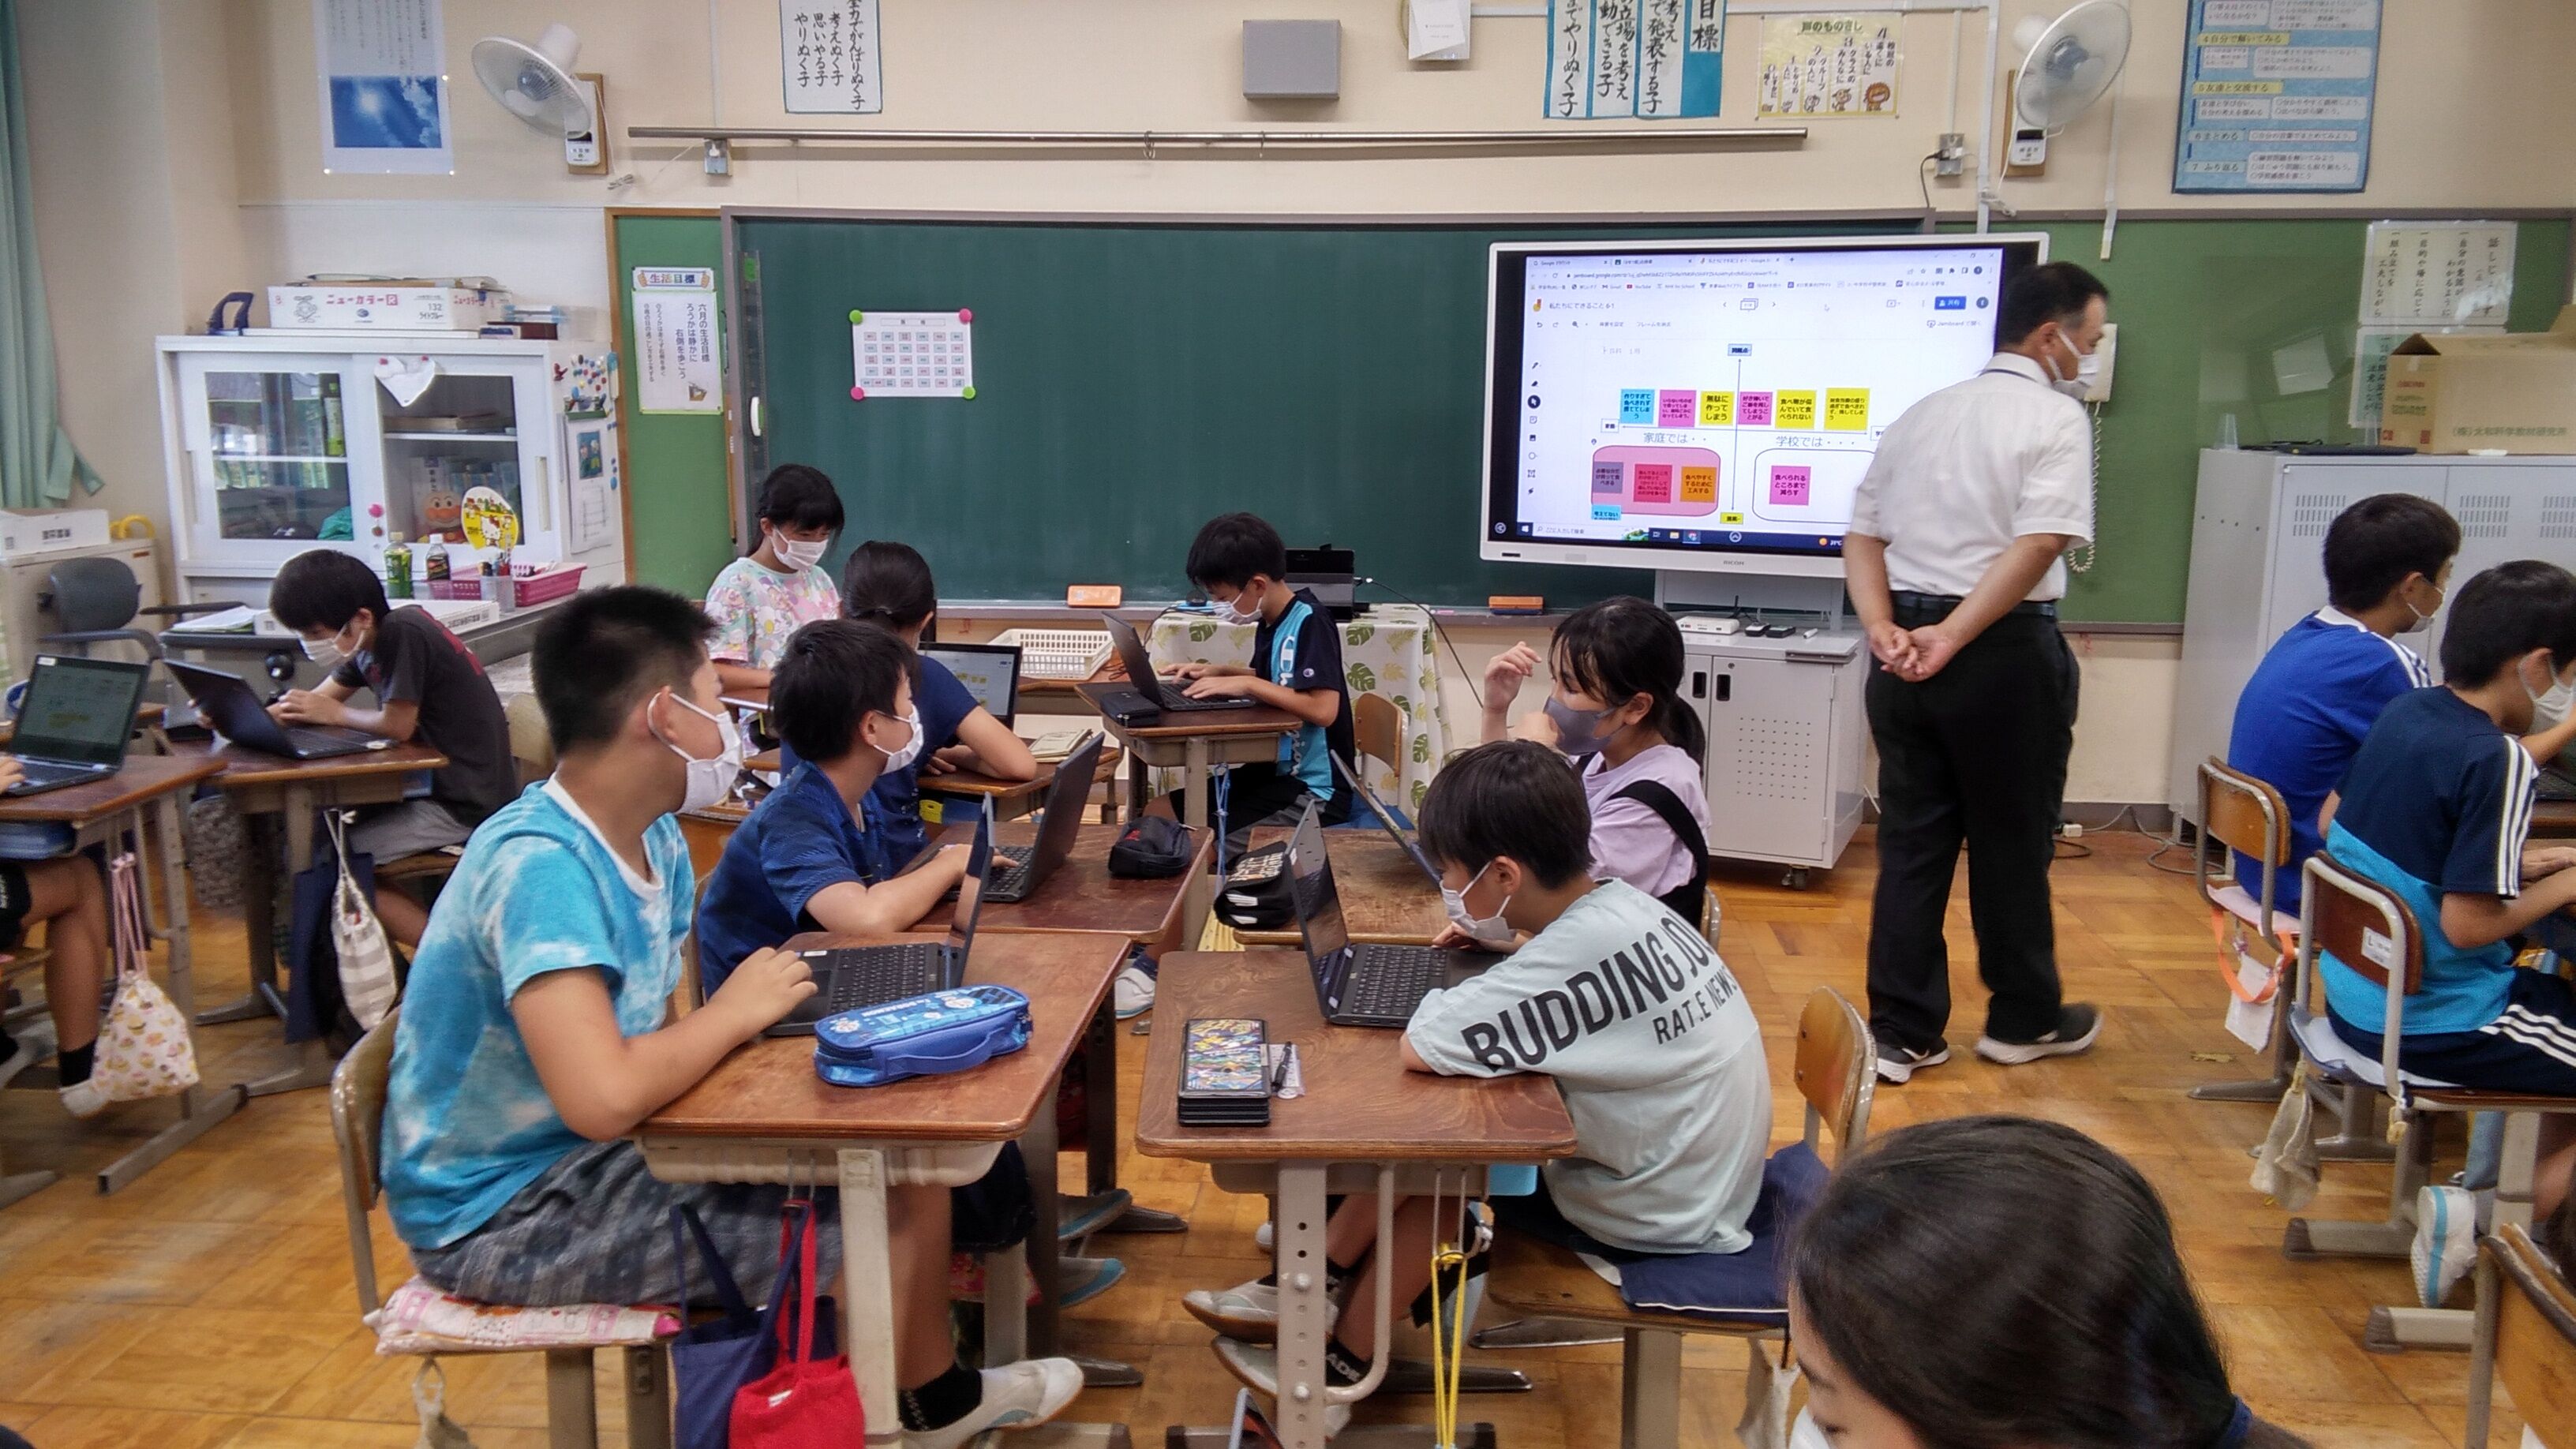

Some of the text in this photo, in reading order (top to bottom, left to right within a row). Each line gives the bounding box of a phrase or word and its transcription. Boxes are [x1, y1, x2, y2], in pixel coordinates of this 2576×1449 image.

[794, 12, 811, 88] やりぬく子
[813, 12, 828, 87] 思いやる子
[829, 11, 844, 87] 考えぬく子
[1614, 0, 1637, 99] 立場を考え
[1692, 0, 1719, 51] 目標
[650, 274, 695, 283] 生活目標
[1461, 931, 1686, 1073] BUDDING
